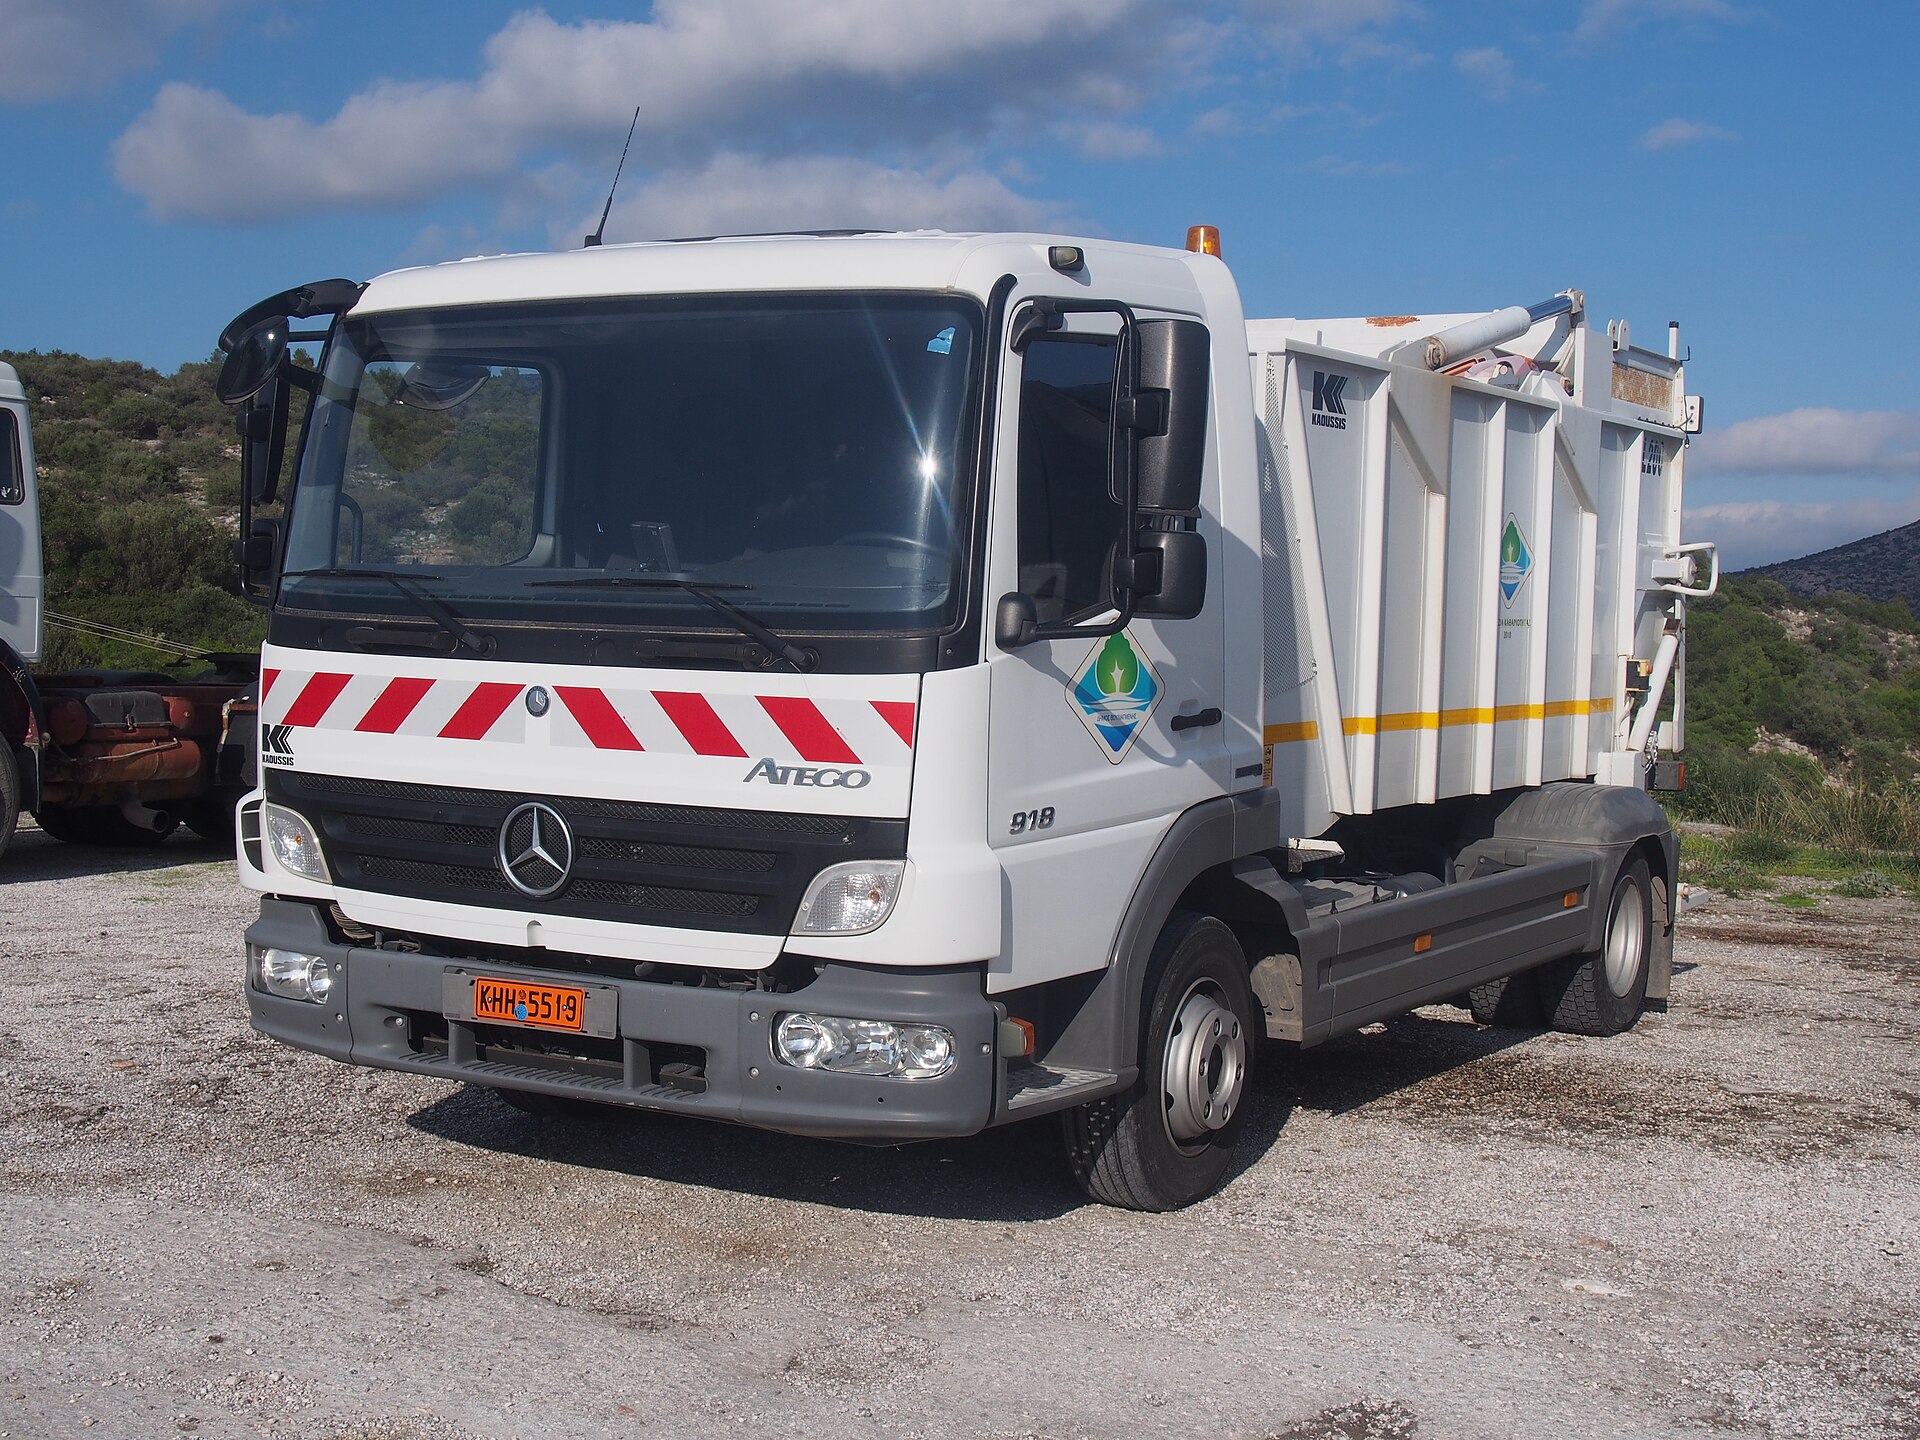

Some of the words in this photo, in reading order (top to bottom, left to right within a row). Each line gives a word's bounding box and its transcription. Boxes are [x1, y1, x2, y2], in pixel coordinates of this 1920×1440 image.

[1311, 413, 1347, 430] KAOUSSIS
[743, 757, 871, 789] ATEGO
[1009, 807, 1055, 835] 918
